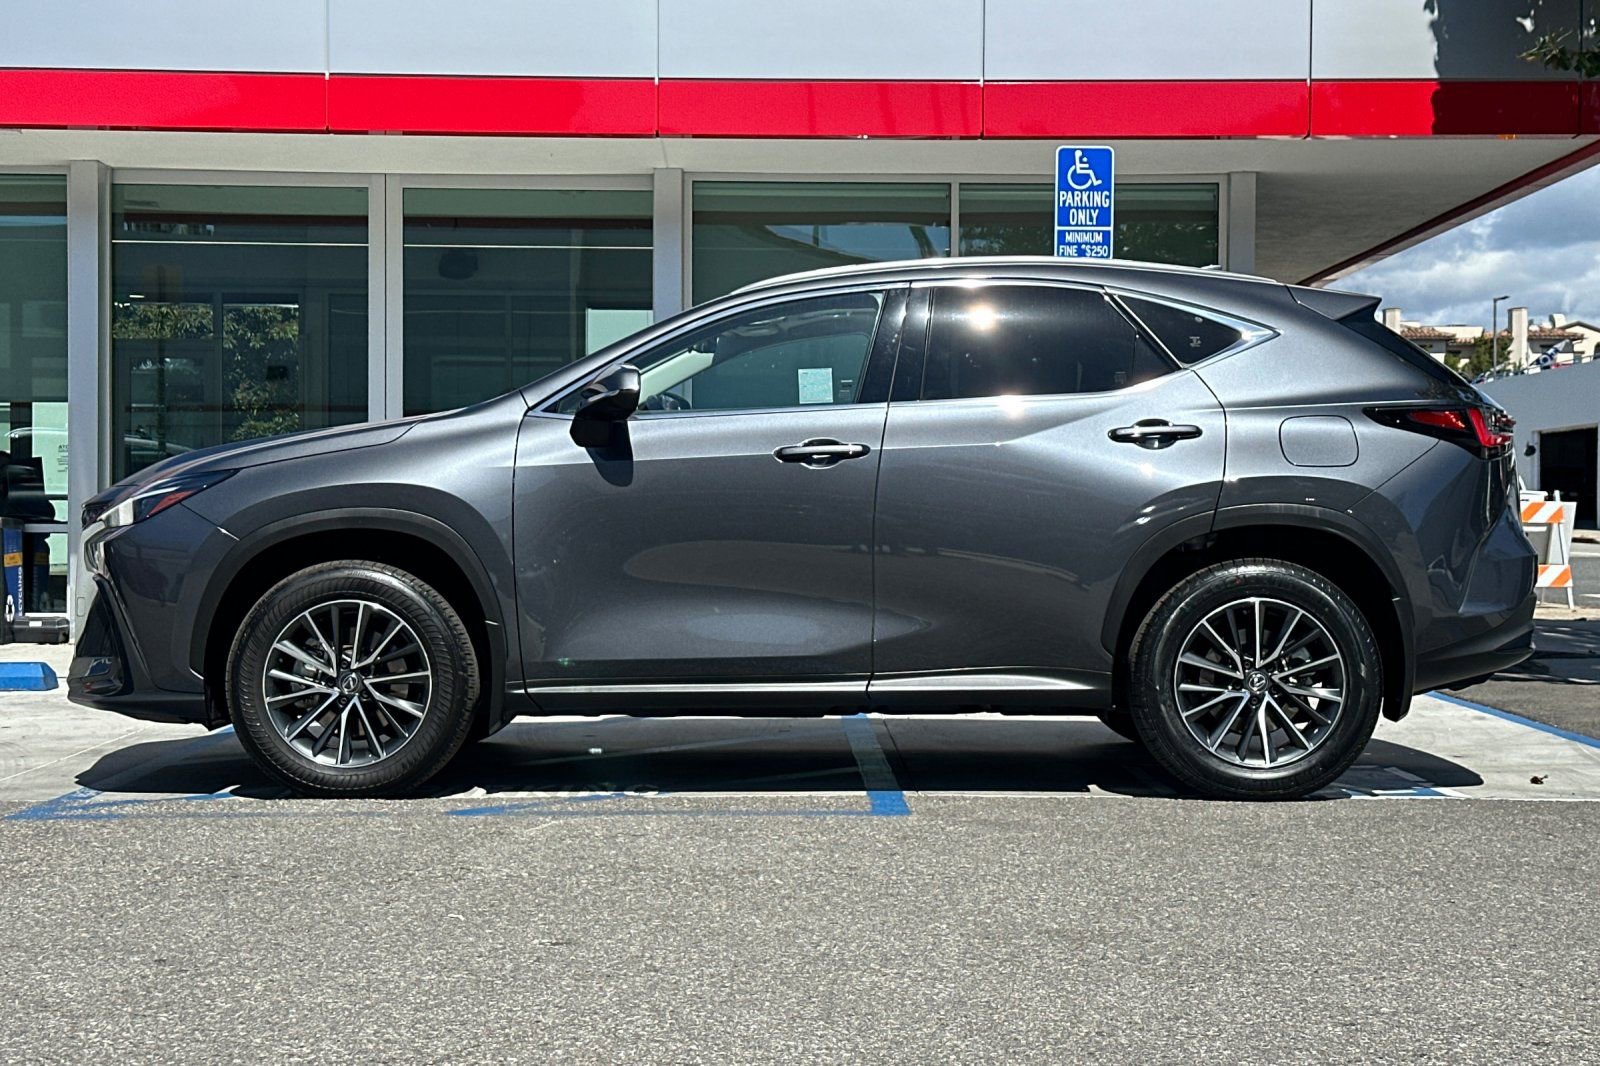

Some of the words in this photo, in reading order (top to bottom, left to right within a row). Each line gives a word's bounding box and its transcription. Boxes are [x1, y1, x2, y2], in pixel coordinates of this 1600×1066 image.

[1059, 191, 1110, 208] PARKING
[1069, 208, 1099, 226] ONLY
[1065, 231, 1103, 244] MINIMUM
[1059, 244, 1079, 257] FINE
